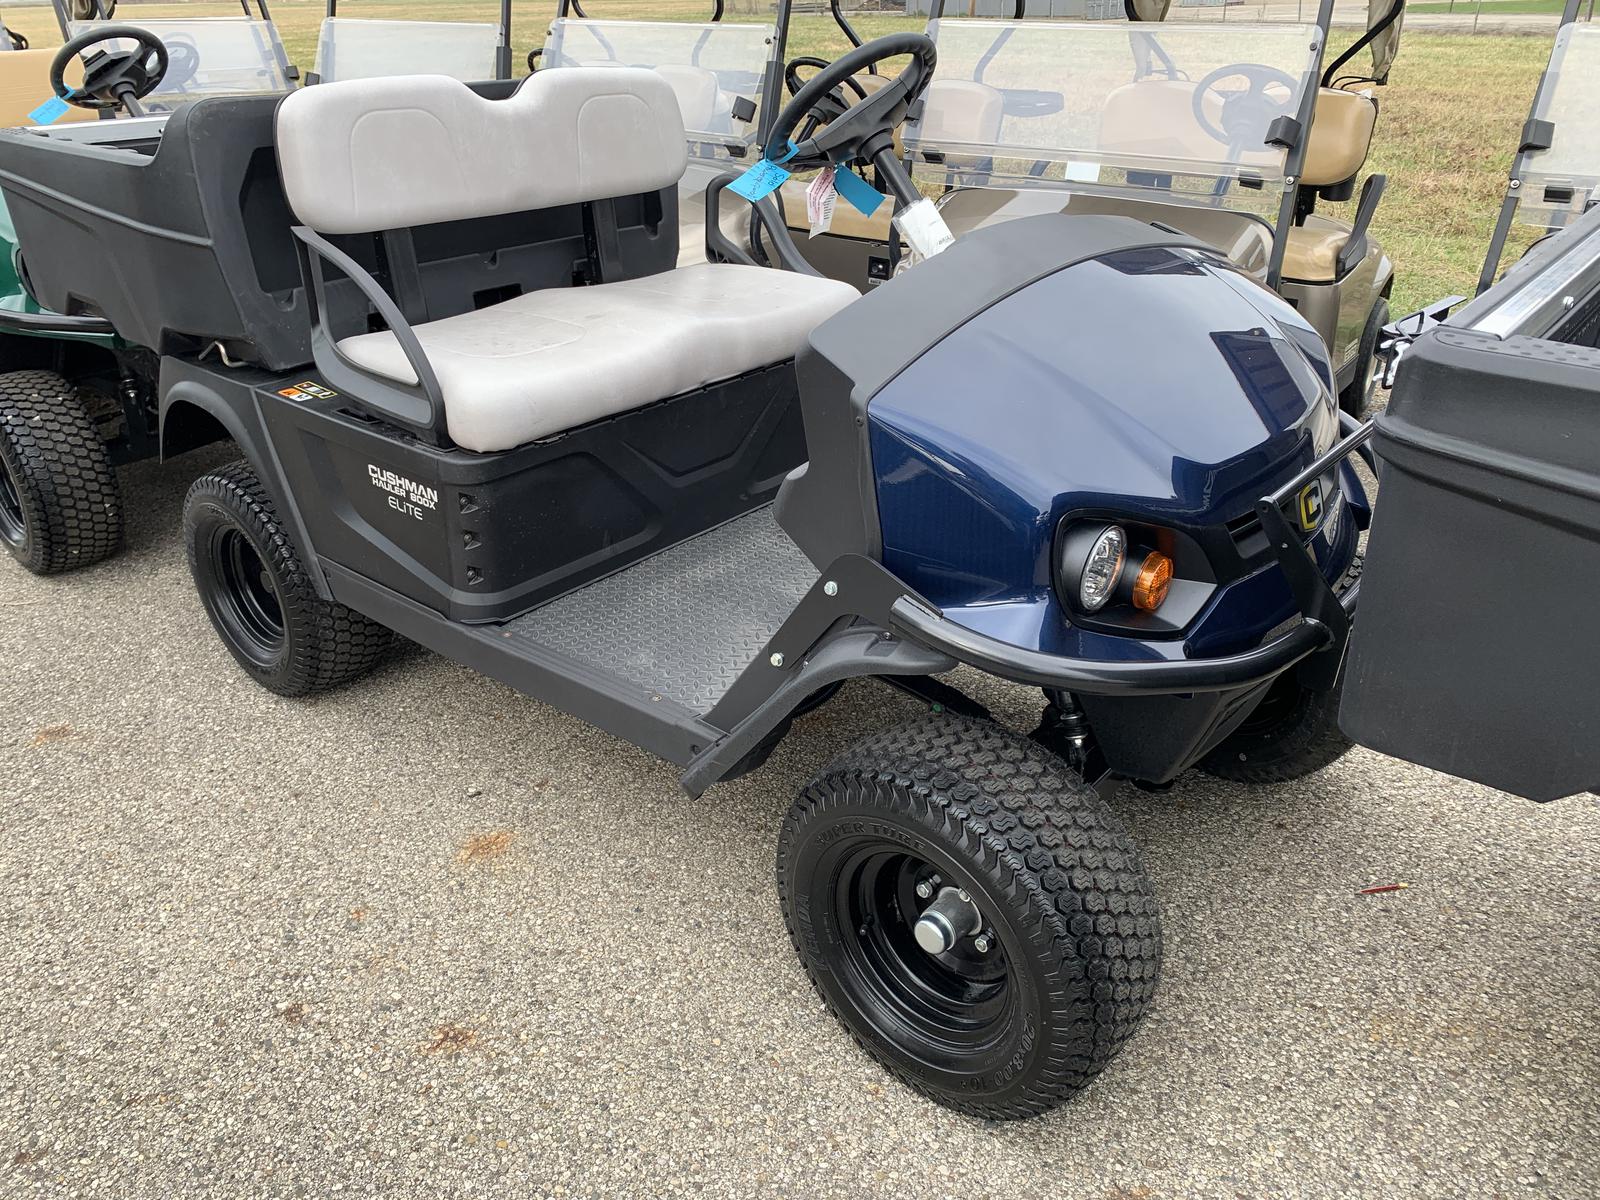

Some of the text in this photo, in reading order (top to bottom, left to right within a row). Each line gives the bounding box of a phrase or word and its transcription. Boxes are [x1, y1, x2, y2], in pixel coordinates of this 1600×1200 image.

[367, 463, 438, 503] CUSHMAN
[372, 477, 436, 510] HAULER 800X
